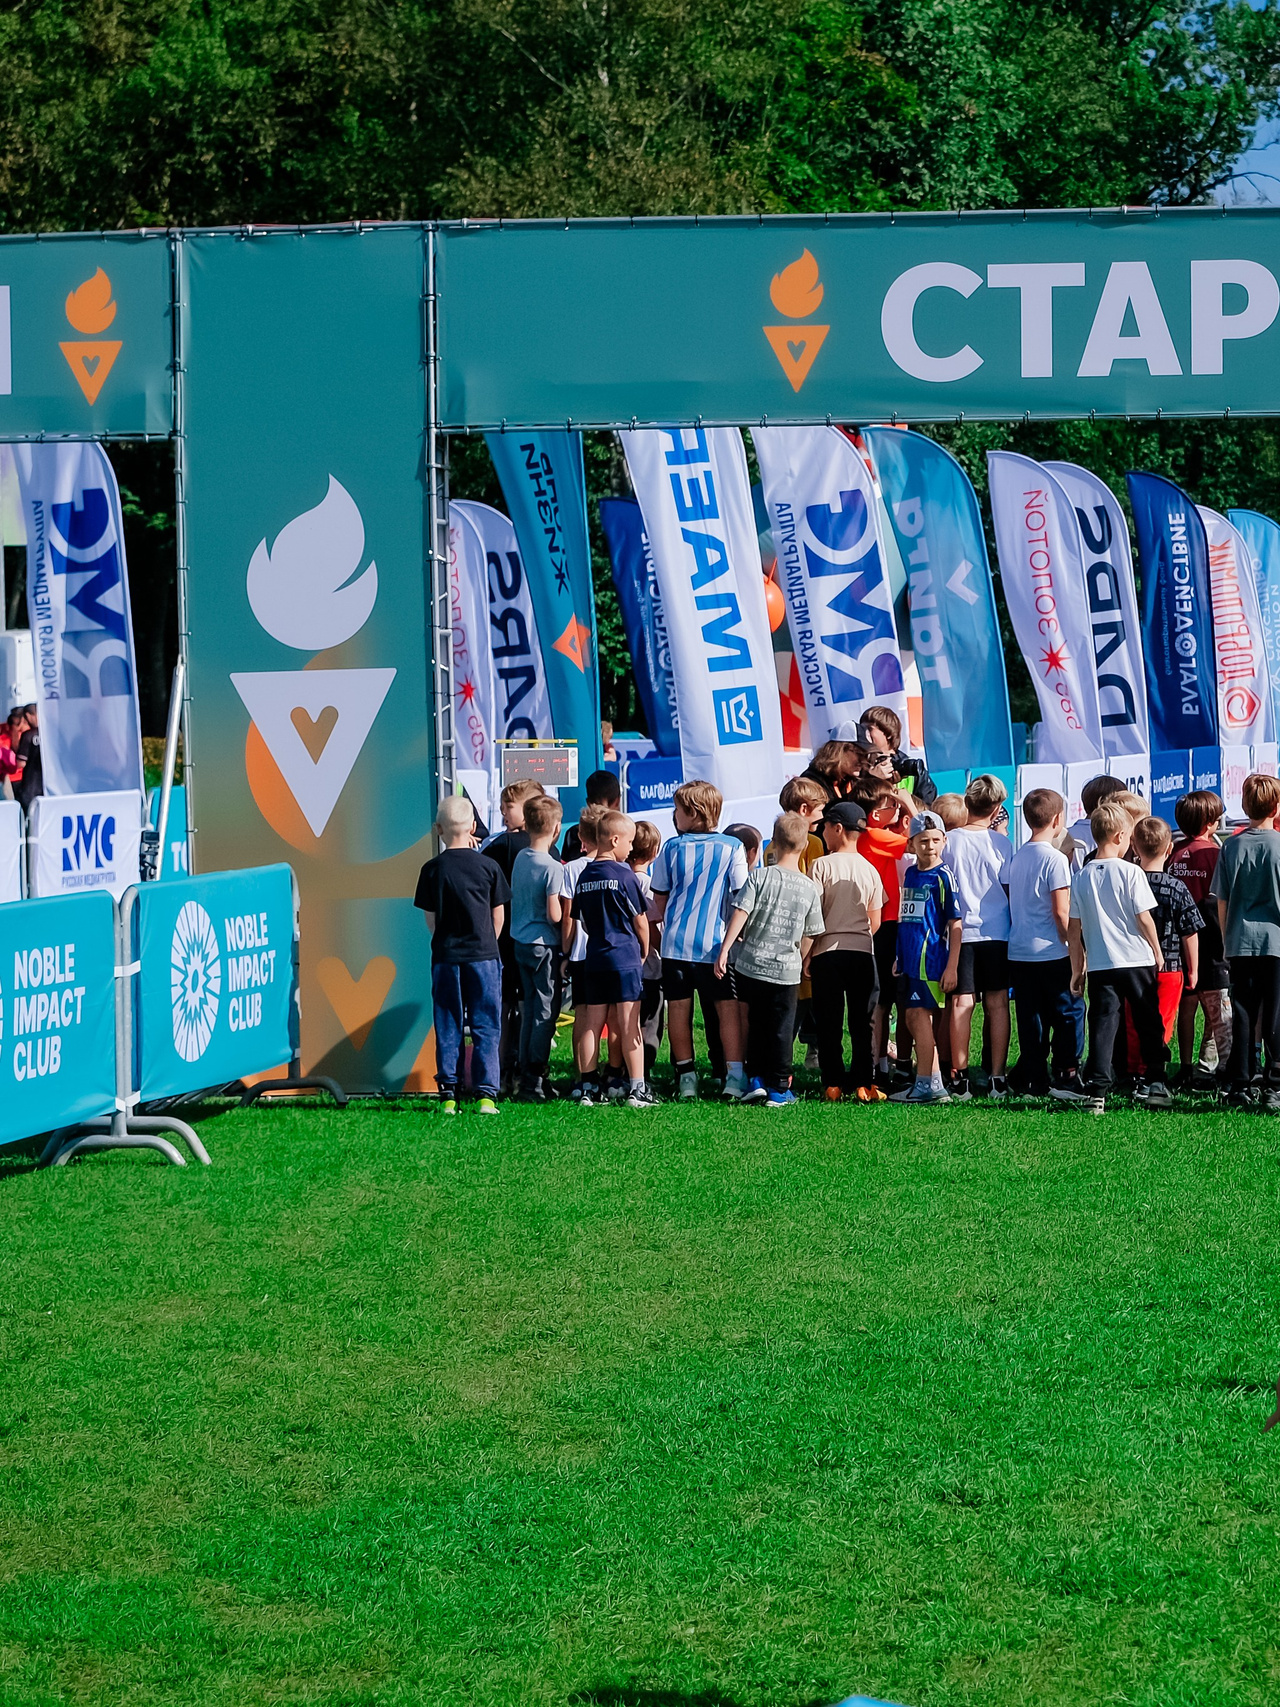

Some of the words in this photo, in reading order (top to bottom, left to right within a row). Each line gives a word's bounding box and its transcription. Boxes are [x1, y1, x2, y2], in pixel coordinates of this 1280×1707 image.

[225, 912, 269, 951] NOBLE
[14, 943, 76, 990] NOBLE
[228, 950, 276, 993] IMPACT
[13, 987, 85, 1036] IMPACT
[228, 992, 262, 1033] CLUB
[13, 1036, 61, 1082] CLUB
